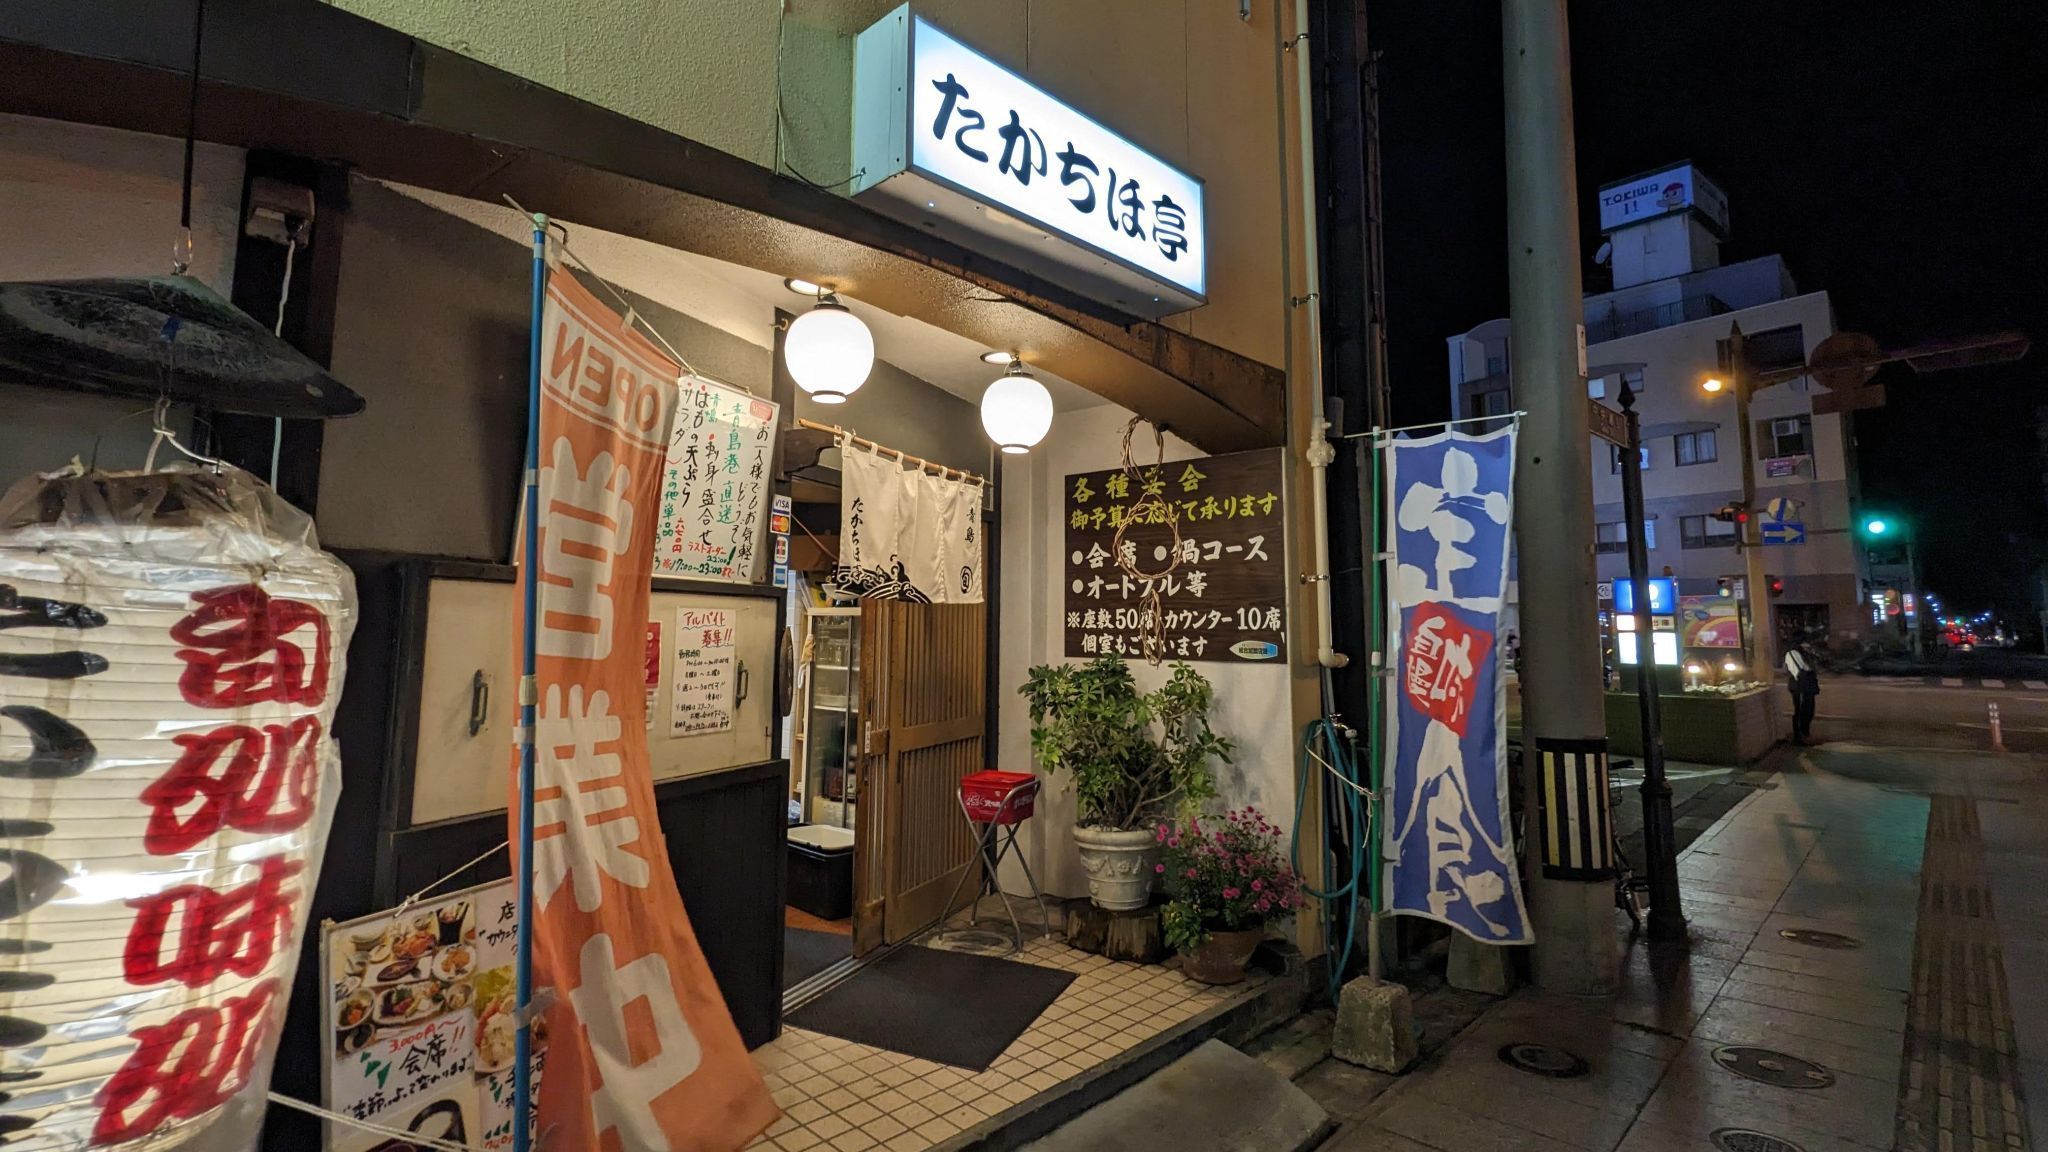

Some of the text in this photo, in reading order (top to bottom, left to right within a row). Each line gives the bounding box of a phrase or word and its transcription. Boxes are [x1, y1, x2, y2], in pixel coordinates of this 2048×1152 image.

[931, 73, 1188, 262] たかちほ亭
[681, 389, 710, 509] はもの天ぷら
[775, 499, 790, 509] VISA
